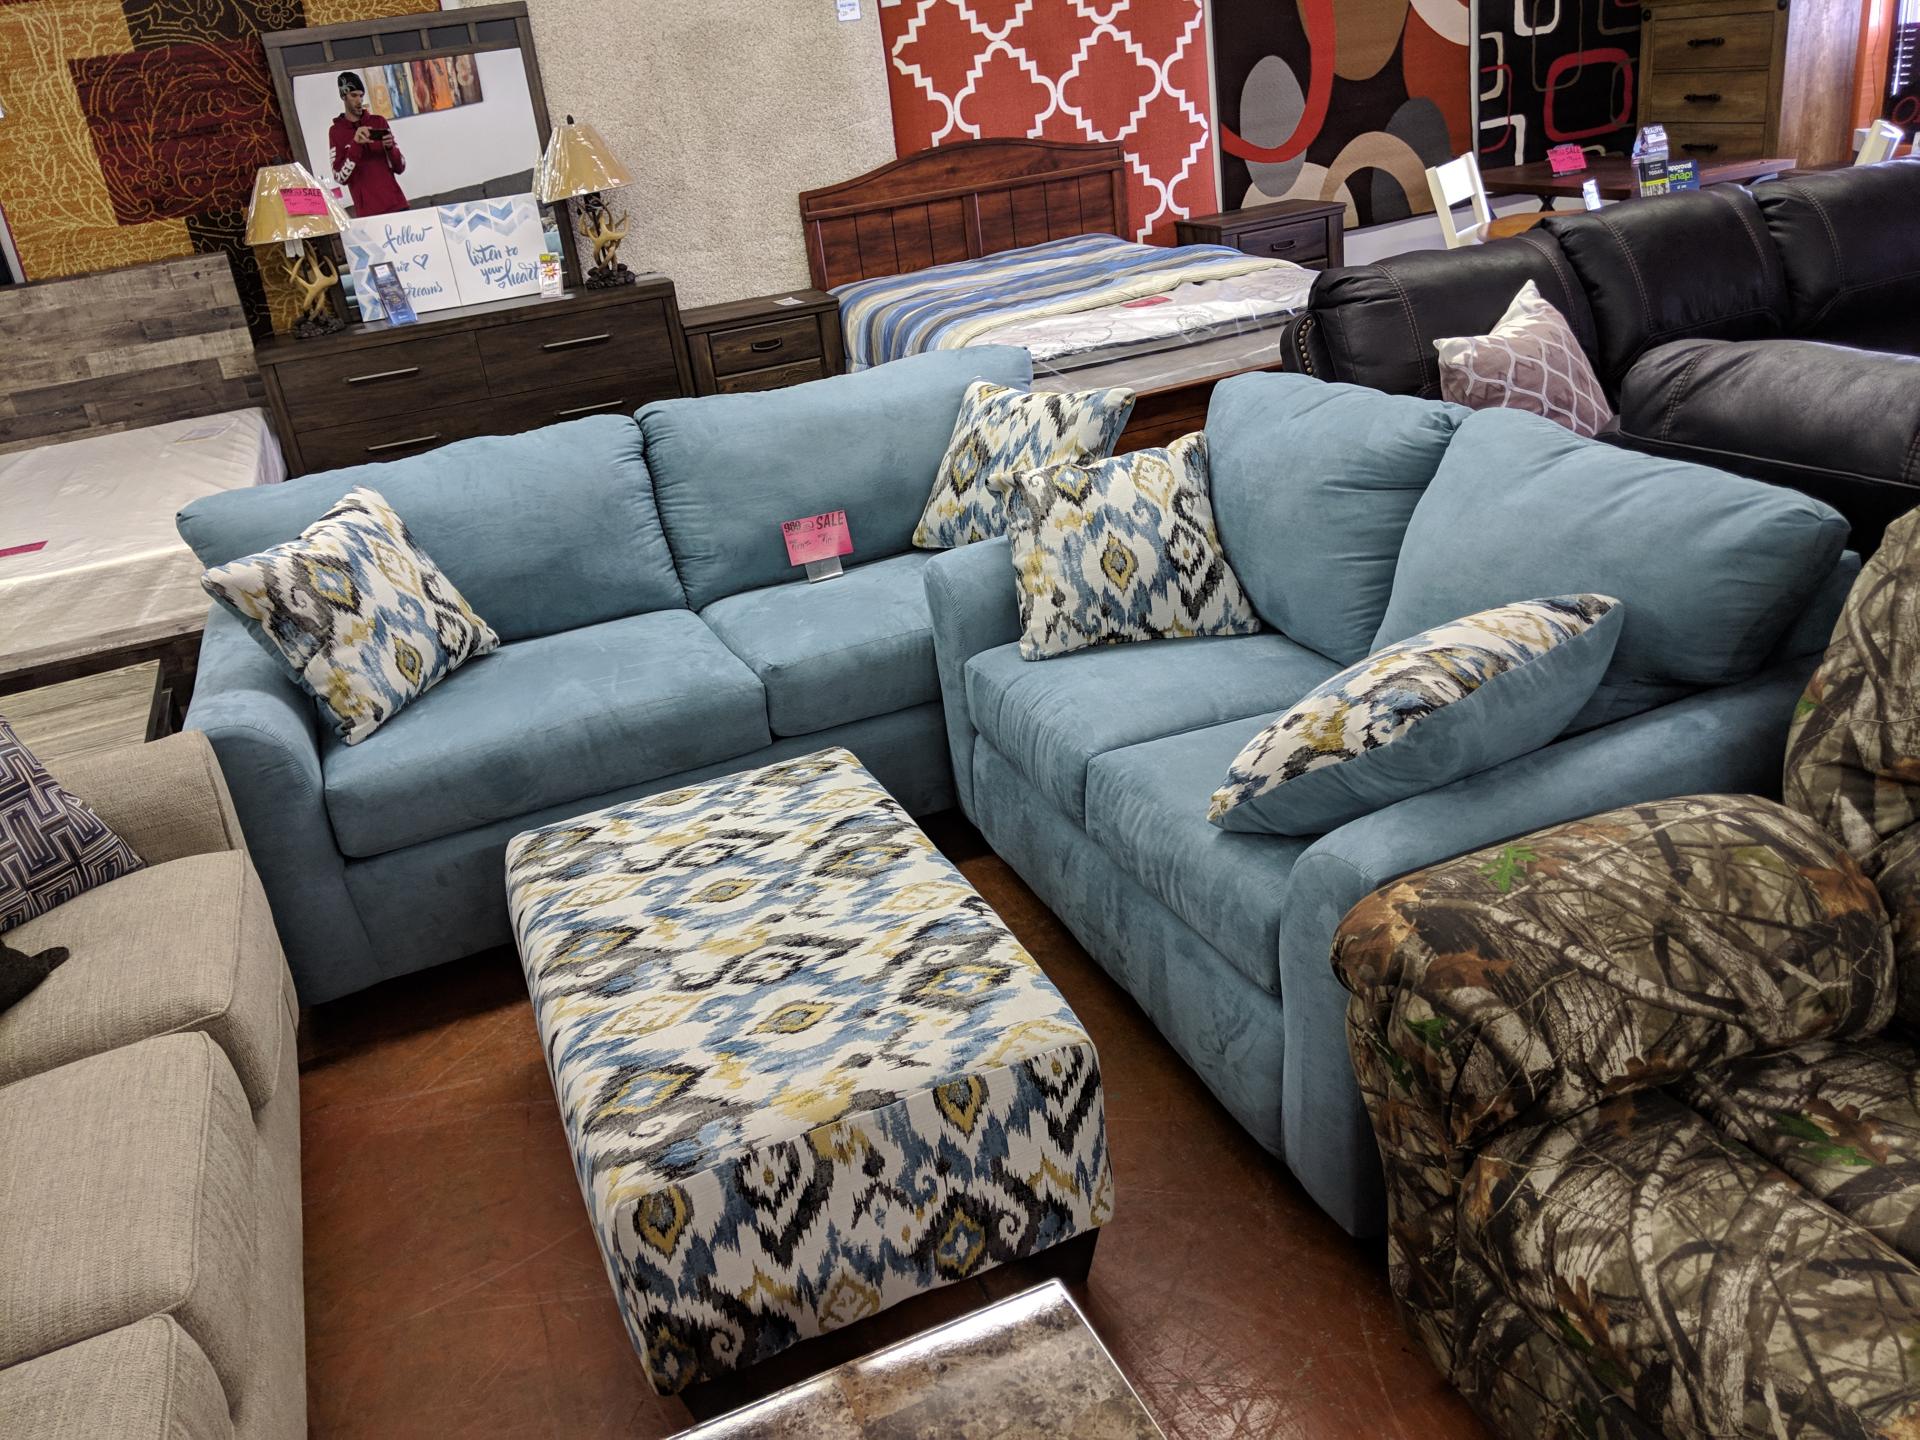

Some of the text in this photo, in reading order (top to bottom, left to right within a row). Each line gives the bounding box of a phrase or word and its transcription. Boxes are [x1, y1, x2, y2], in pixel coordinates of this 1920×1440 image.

[1669, 171, 1693, 181] snap!
[302, 188, 321, 197] SALE
[382, 224, 433, 253] follow
[465, 239, 519, 266] listen to
[480, 265, 504, 285] your
[494, 258, 540, 287] heart
[816, 511, 844, 530] SALE
